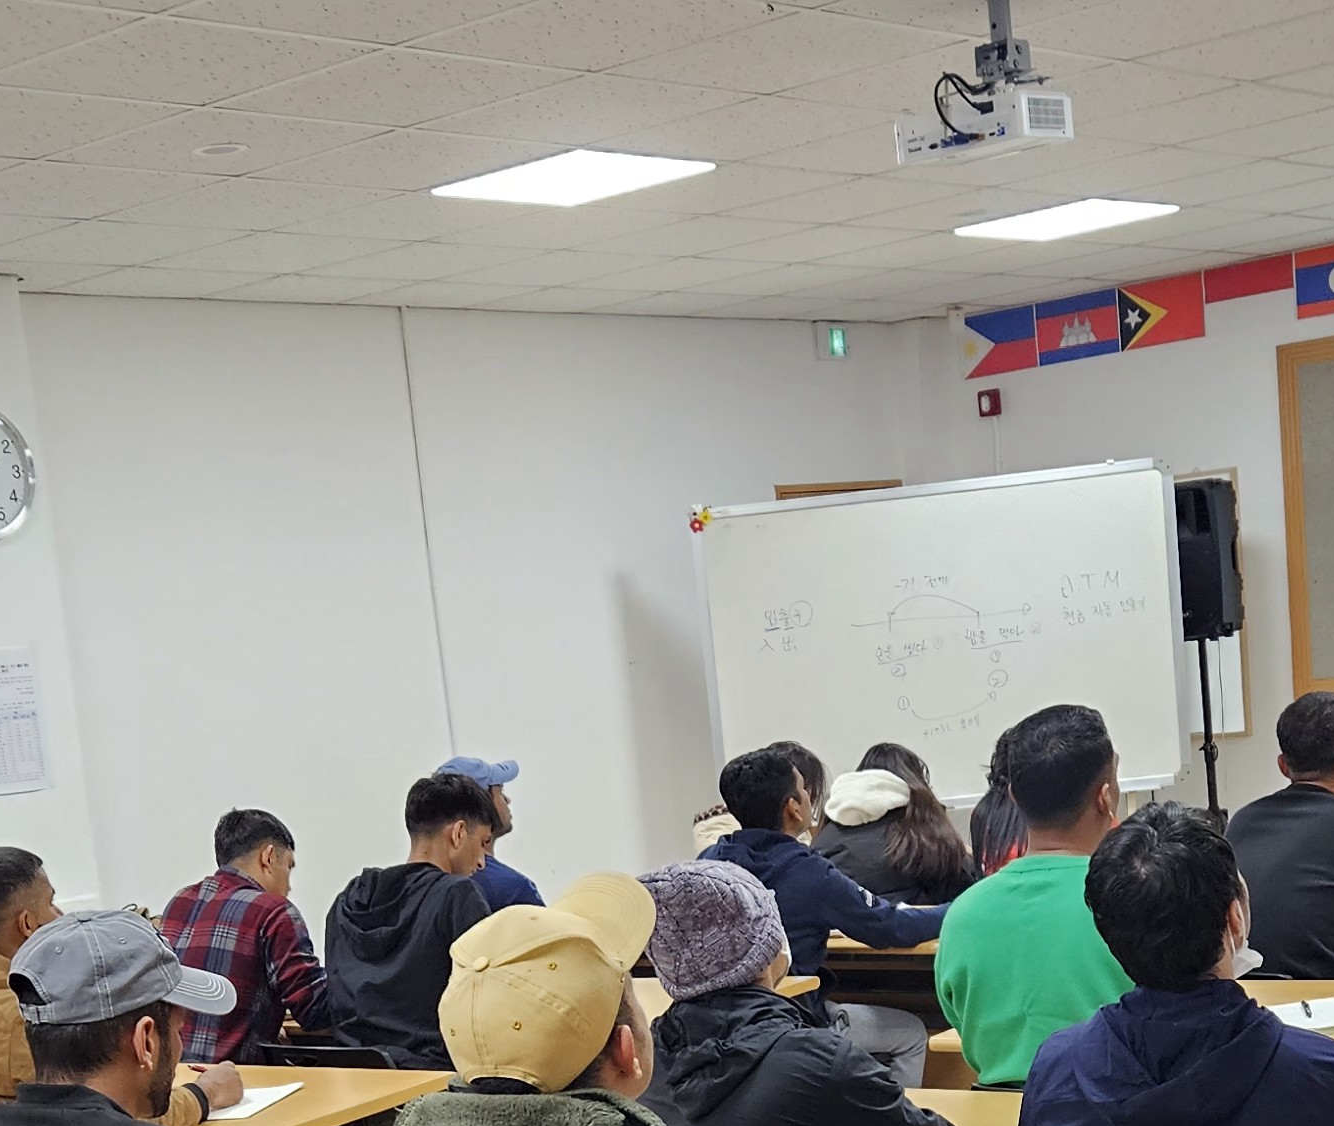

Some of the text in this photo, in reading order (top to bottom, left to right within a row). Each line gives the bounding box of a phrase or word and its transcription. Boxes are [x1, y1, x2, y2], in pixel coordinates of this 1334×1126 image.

[1, 439, 11, 454] 2
[11, 464, 21, 479] 3
[9, 489, 18, 502] 4
